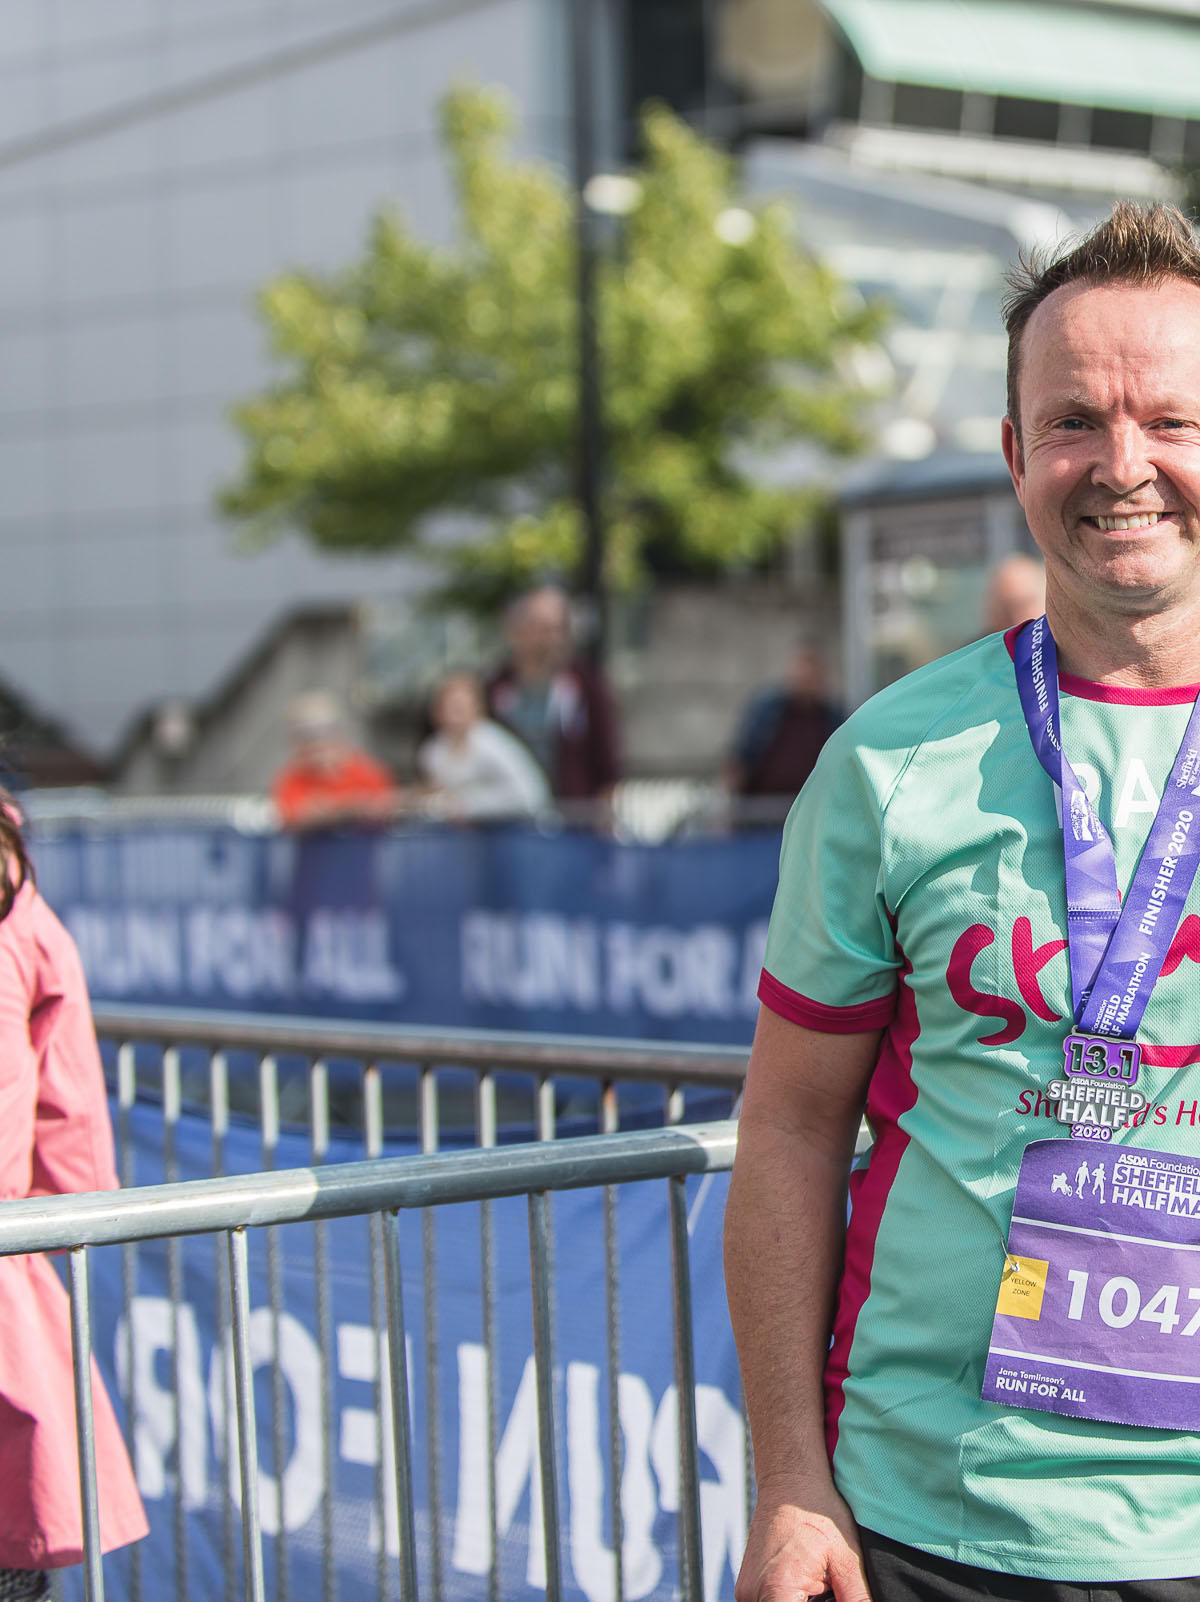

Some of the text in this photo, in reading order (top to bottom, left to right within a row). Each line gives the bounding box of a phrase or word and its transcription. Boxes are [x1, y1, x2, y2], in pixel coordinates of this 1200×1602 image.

[1032, 617, 1048, 712] FINISHER 2020
[1046, 714, 1060, 751] ATHON
[1176, 748, 1198, 789] Sheffield
[1139, 810, 1193, 935] FINISHER 2020
[460, 910, 598, 1011] RUN
[605, 921, 737, 1018] FOR
[1116, 952, 1151, 1025] MARATHON
[1098, 994, 1121, 1034] EFFIELD
[1070, 1042, 1135, 1078] 13.1
[1050, 1083, 1144, 1109] SHEFFIELD
[1090, 1080, 1126, 1090] Foundation
[1060, 1100, 1127, 1128] HALF
[1074, 1124, 1110, 1140] 2020
[1118, 1154, 1149, 1167] ASDA
[1112, 1186, 1168, 1211] HALF
[1011, 1277, 1037, 1287] YELLOW
[1012, 1288, 1030, 1297] ZONE
[996, 1376, 1086, 1403] RUN FOR ALL
[998, 1367, 1065, 1385] Jane Tomlinson's
